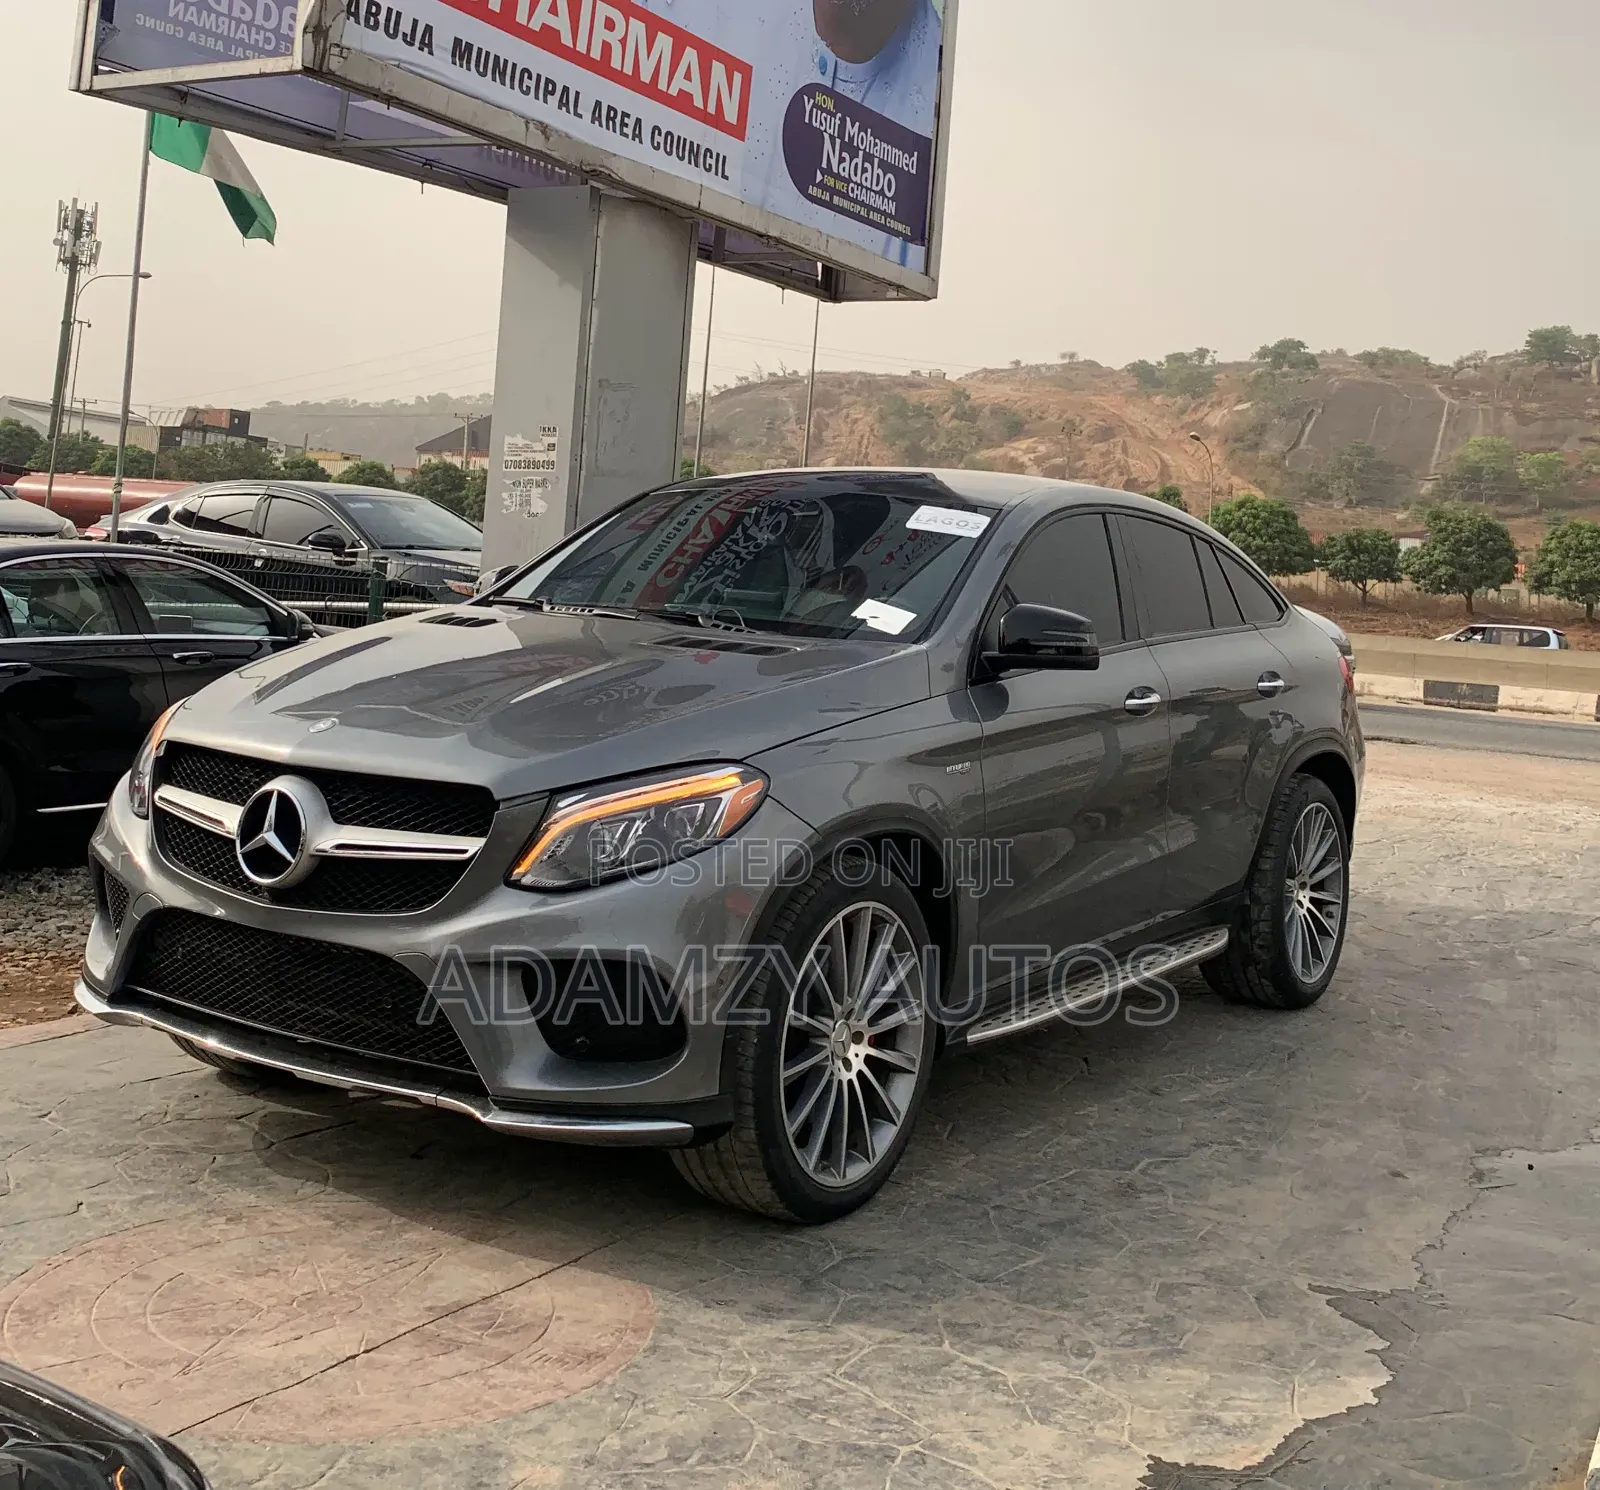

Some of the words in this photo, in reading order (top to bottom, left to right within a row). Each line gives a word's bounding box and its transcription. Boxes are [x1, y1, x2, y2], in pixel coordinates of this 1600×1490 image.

[472, 0, 743, 125] AIRMAN
[346, 0, 434, 56] ABUJA
[451, 36, 583, 119] MUNICIPAL
[590, 99, 643, 145] AREA
[650, 125, 729, 180] COUNCIL
[815, 91, 836, 113] HON.
[803, 95, 842, 137] Yusuf
[844, 116, 918, 175] Mohammed
[821, 132, 896, 198] Nadabo
[807, 185, 830, 202] ABUJA
[832, 195, 868, 218] MUNICIPAL
[868, 210, 886, 225] AREA
[886, 217, 912, 236] COUNCIL
[824, 175, 834, 188] FOR
[835, 179, 848, 193] VICE
[848, 182, 896, 215] CHAIRMAN
[504, 459, 556, 470] 07083890499
[914, 514, 982, 531] LAGOS
